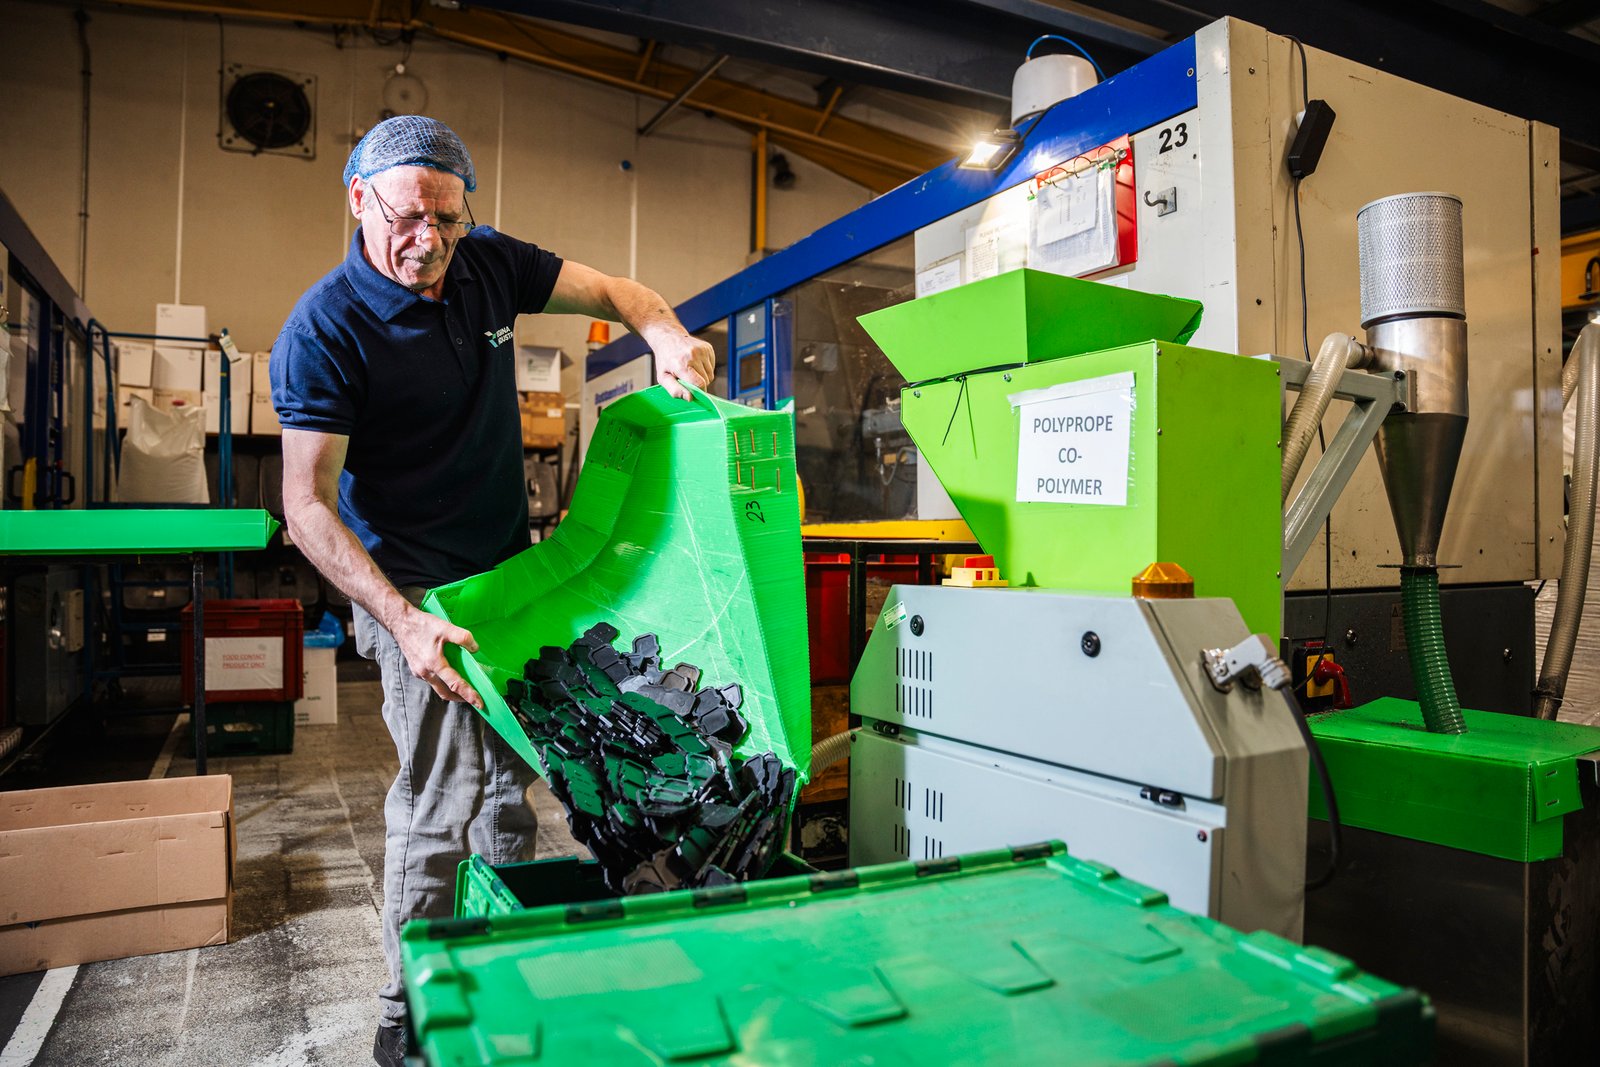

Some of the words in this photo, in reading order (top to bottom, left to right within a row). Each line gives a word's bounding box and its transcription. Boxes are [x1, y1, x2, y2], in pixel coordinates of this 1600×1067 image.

[1159, 123, 1188, 154] 23
[1033, 416, 1113, 433] POLYPROPE
[1058, 447, 1082, 463] CO-
[1037, 478, 1102, 495] POLYMER
[746, 501, 766, 523] 23
